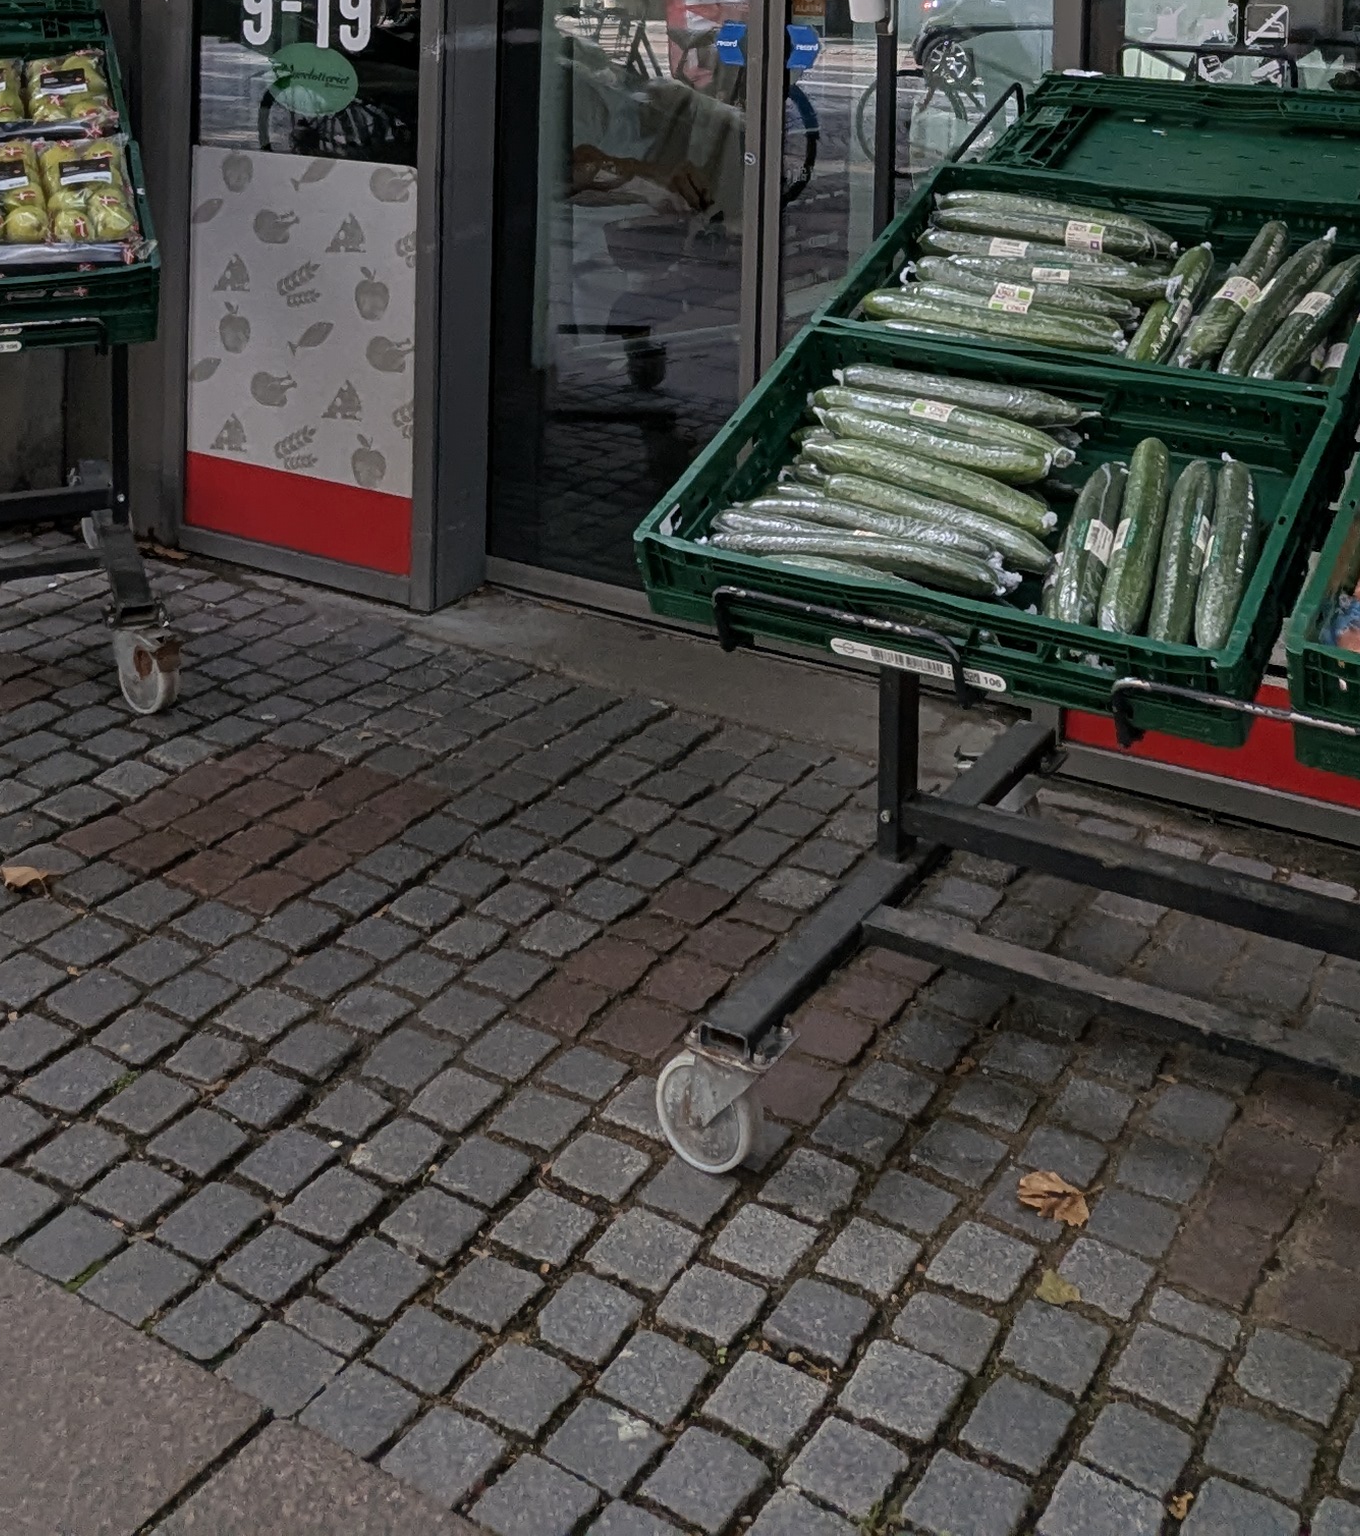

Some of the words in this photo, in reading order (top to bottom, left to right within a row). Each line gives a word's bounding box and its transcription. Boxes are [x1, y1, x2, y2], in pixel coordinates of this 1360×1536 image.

[716, 39, 738, 48] record
[796, 43, 819, 51] record
[982, 675, 1002, 688] 106
